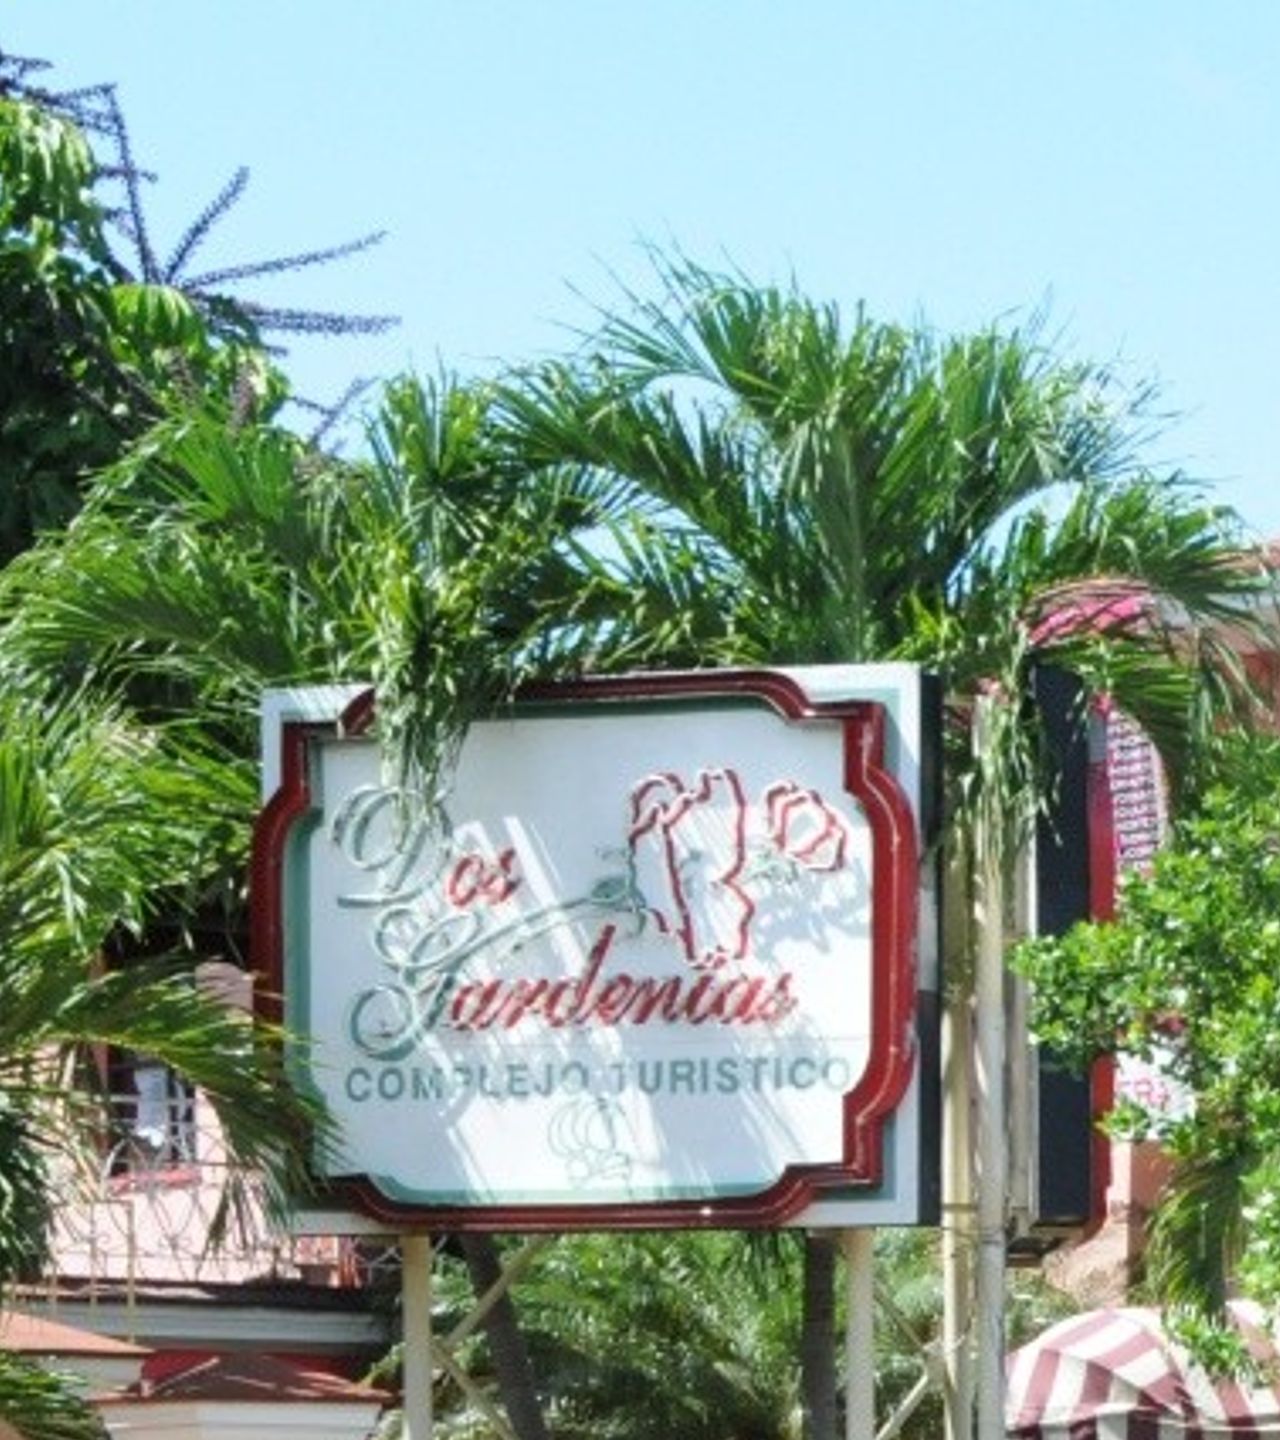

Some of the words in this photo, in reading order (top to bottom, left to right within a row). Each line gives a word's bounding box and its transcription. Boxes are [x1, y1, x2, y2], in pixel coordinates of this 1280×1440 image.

[349, 907, 797, 1060] Gardenias
[346, 1064, 589, 1101] COMPLEJO
[610, 1056, 851, 1096] TURISTICO
